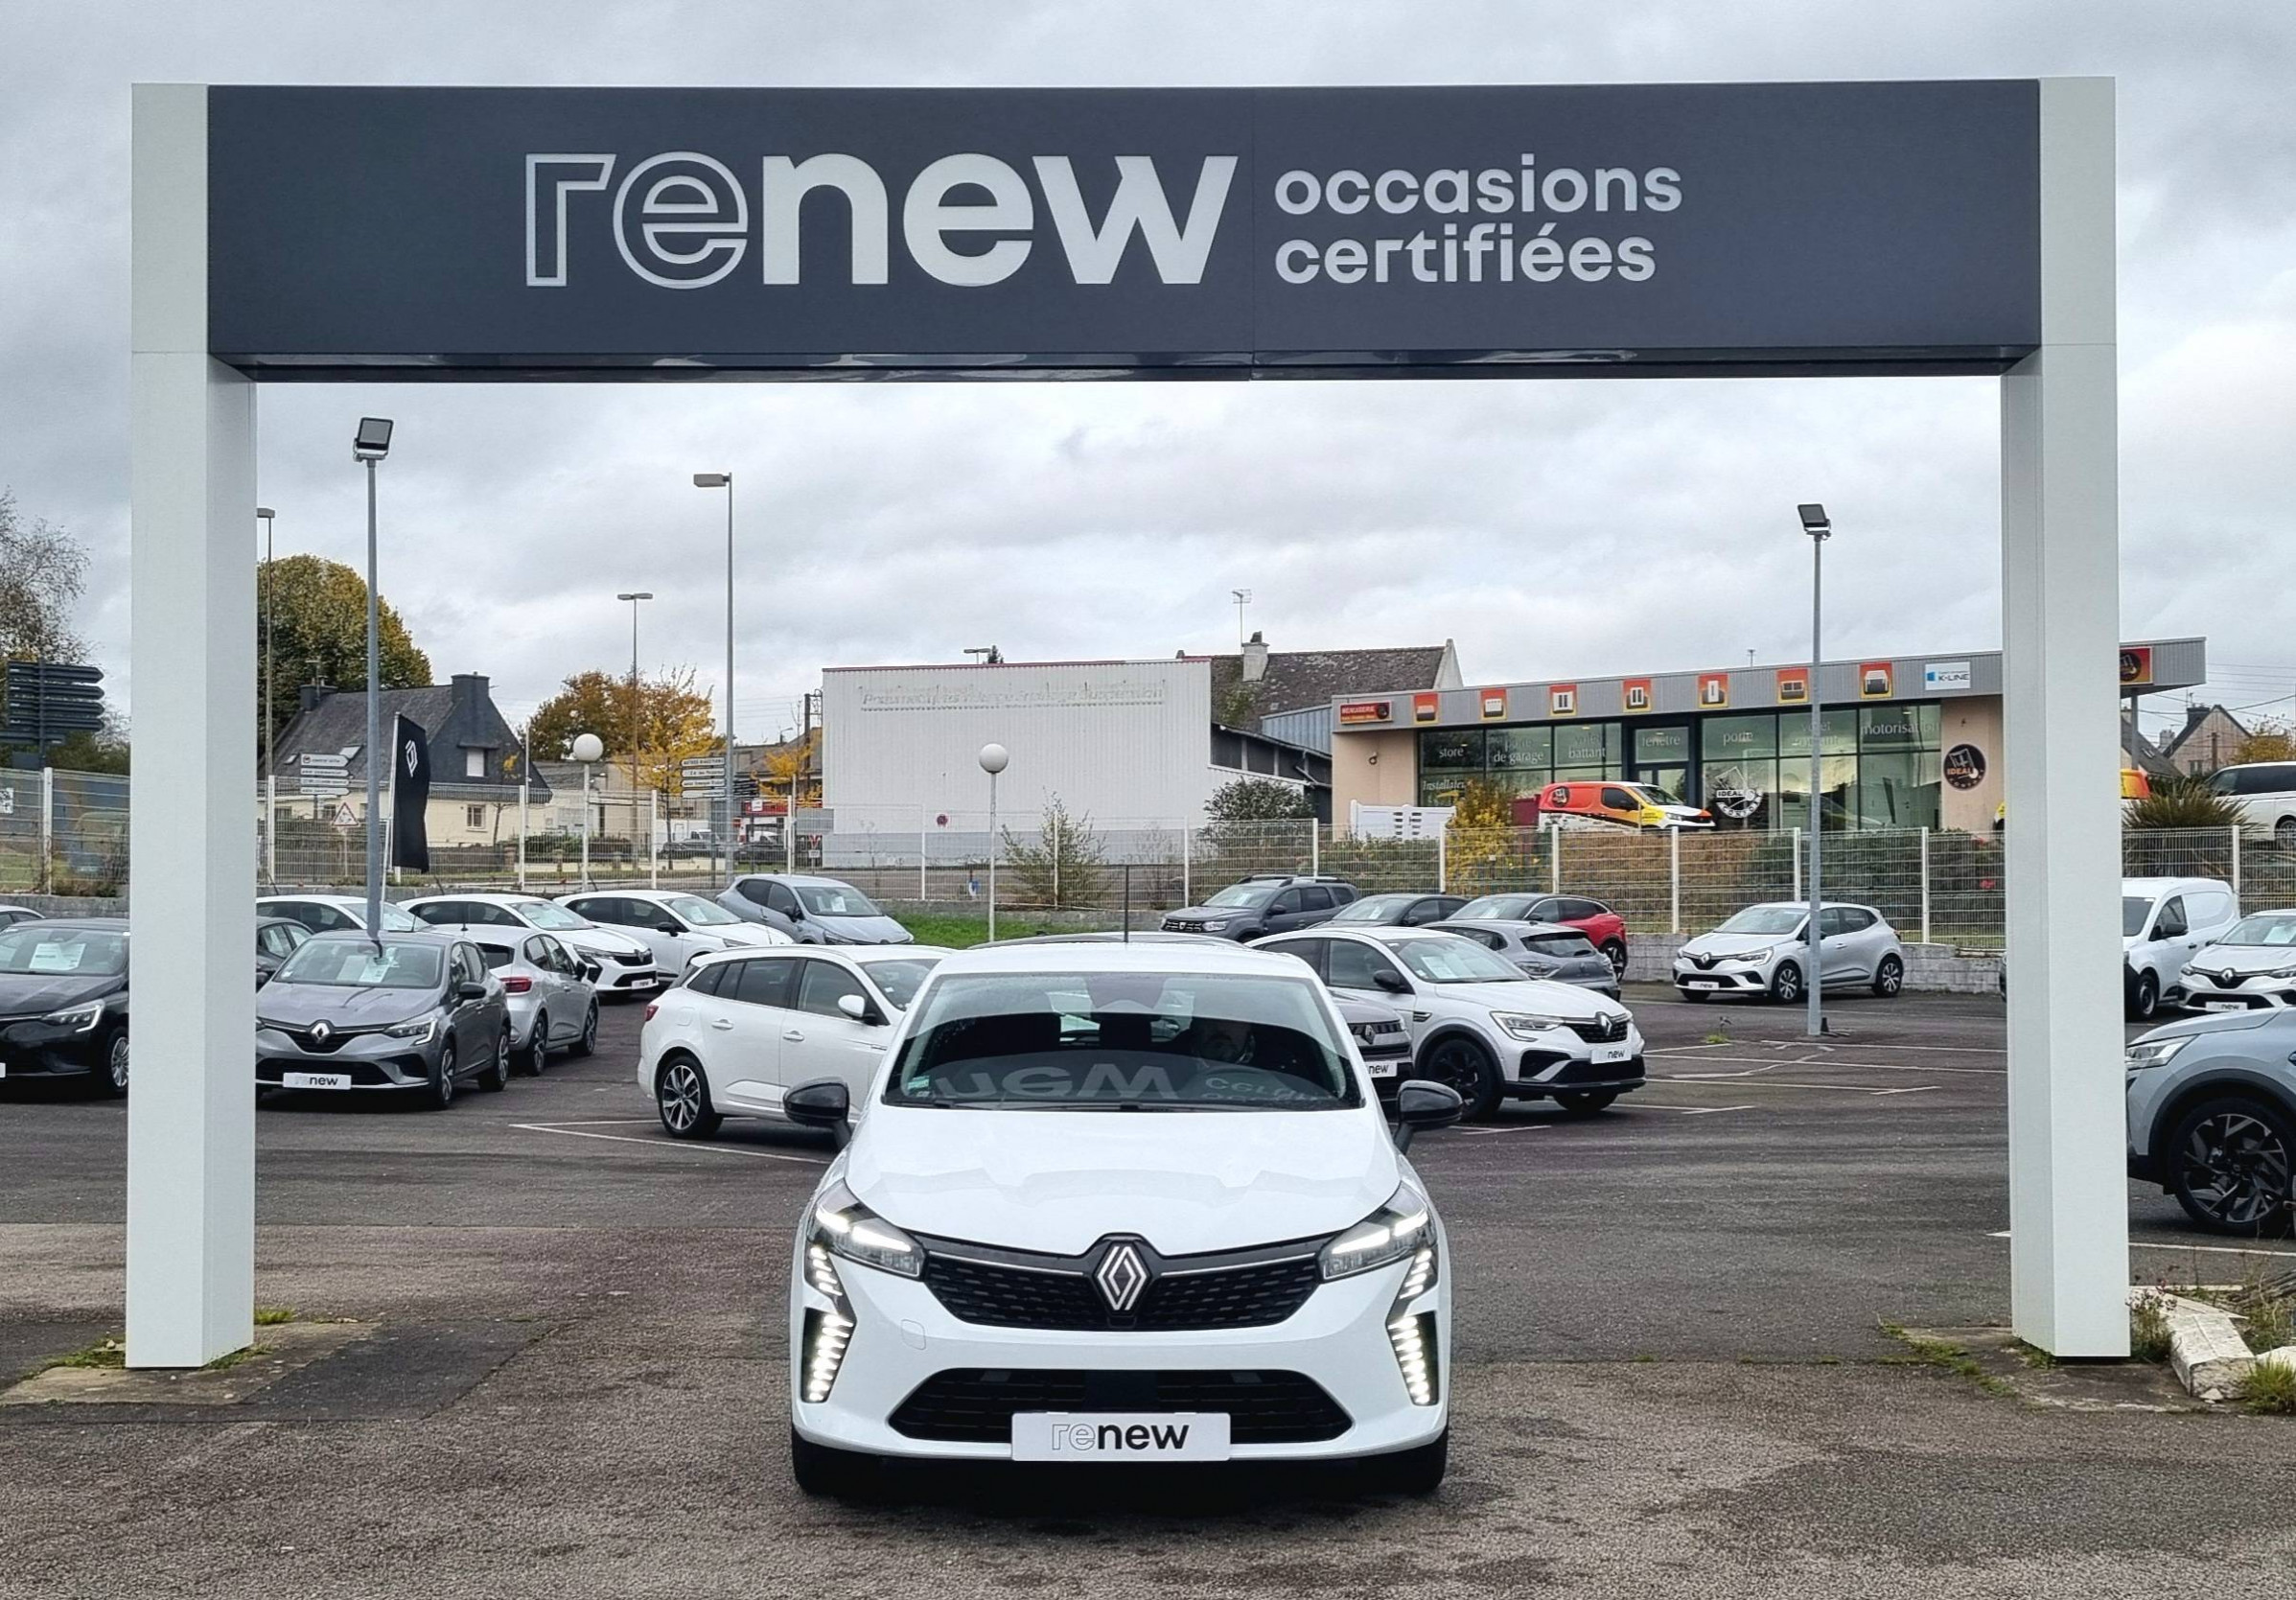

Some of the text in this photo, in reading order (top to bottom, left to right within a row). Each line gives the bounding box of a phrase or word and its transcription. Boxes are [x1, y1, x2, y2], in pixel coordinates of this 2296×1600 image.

[1274, 152, 1682, 216] occasions
[526, 152, 1239, 290] renew
[1274, 221, 1657, 285] certifiées
[1723, 731, 1753, 746] porte
[1439, 748, 1464, 758] store
[1493, 750, 1544, 765] de garage
[1568, 745, 1606, 759] battant
[1947, 767, 1972, 776] IDEAL
[1052, 1424, 1190, 1450] renew
